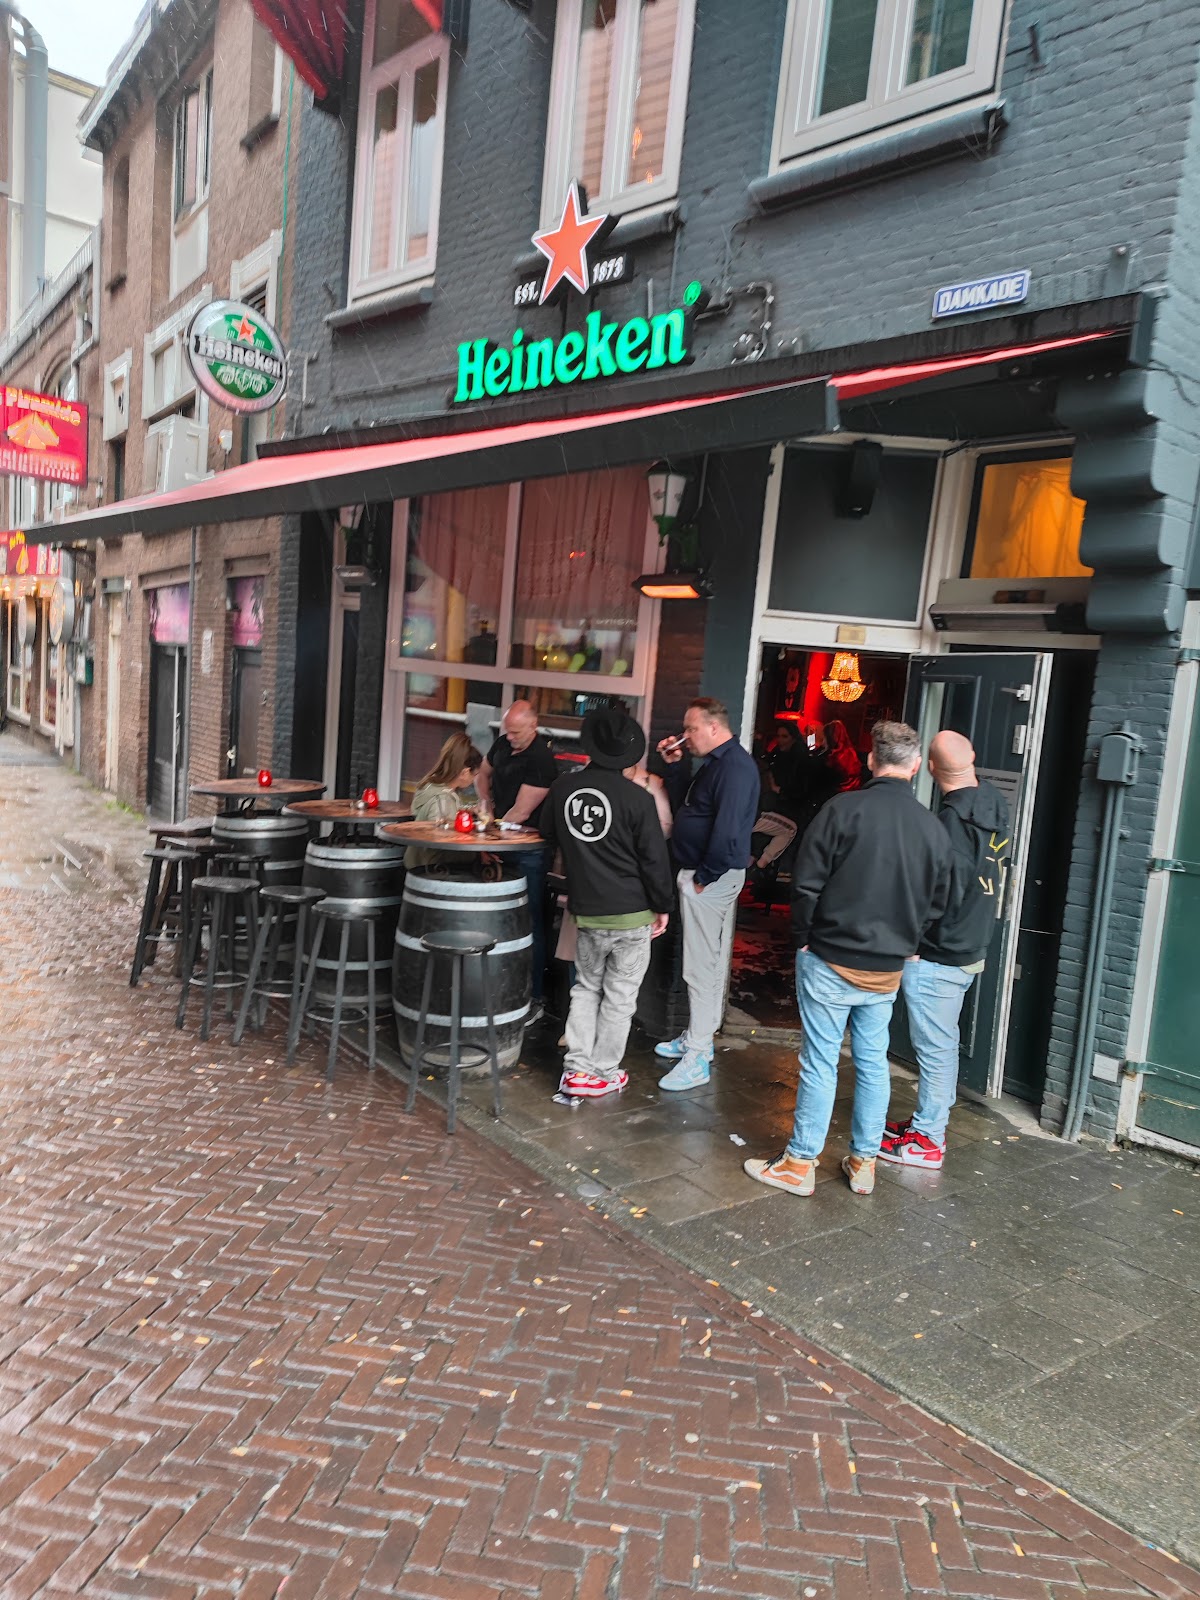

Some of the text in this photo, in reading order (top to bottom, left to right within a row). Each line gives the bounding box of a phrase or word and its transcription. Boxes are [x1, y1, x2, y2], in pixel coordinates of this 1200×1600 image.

[514, 256, 624, 305] EST. 1873
[938, 276, 1024, 313] DAMKADE
[198, 335, 281, 379] Heineken
[453, 308, 687, 403] Heineken
